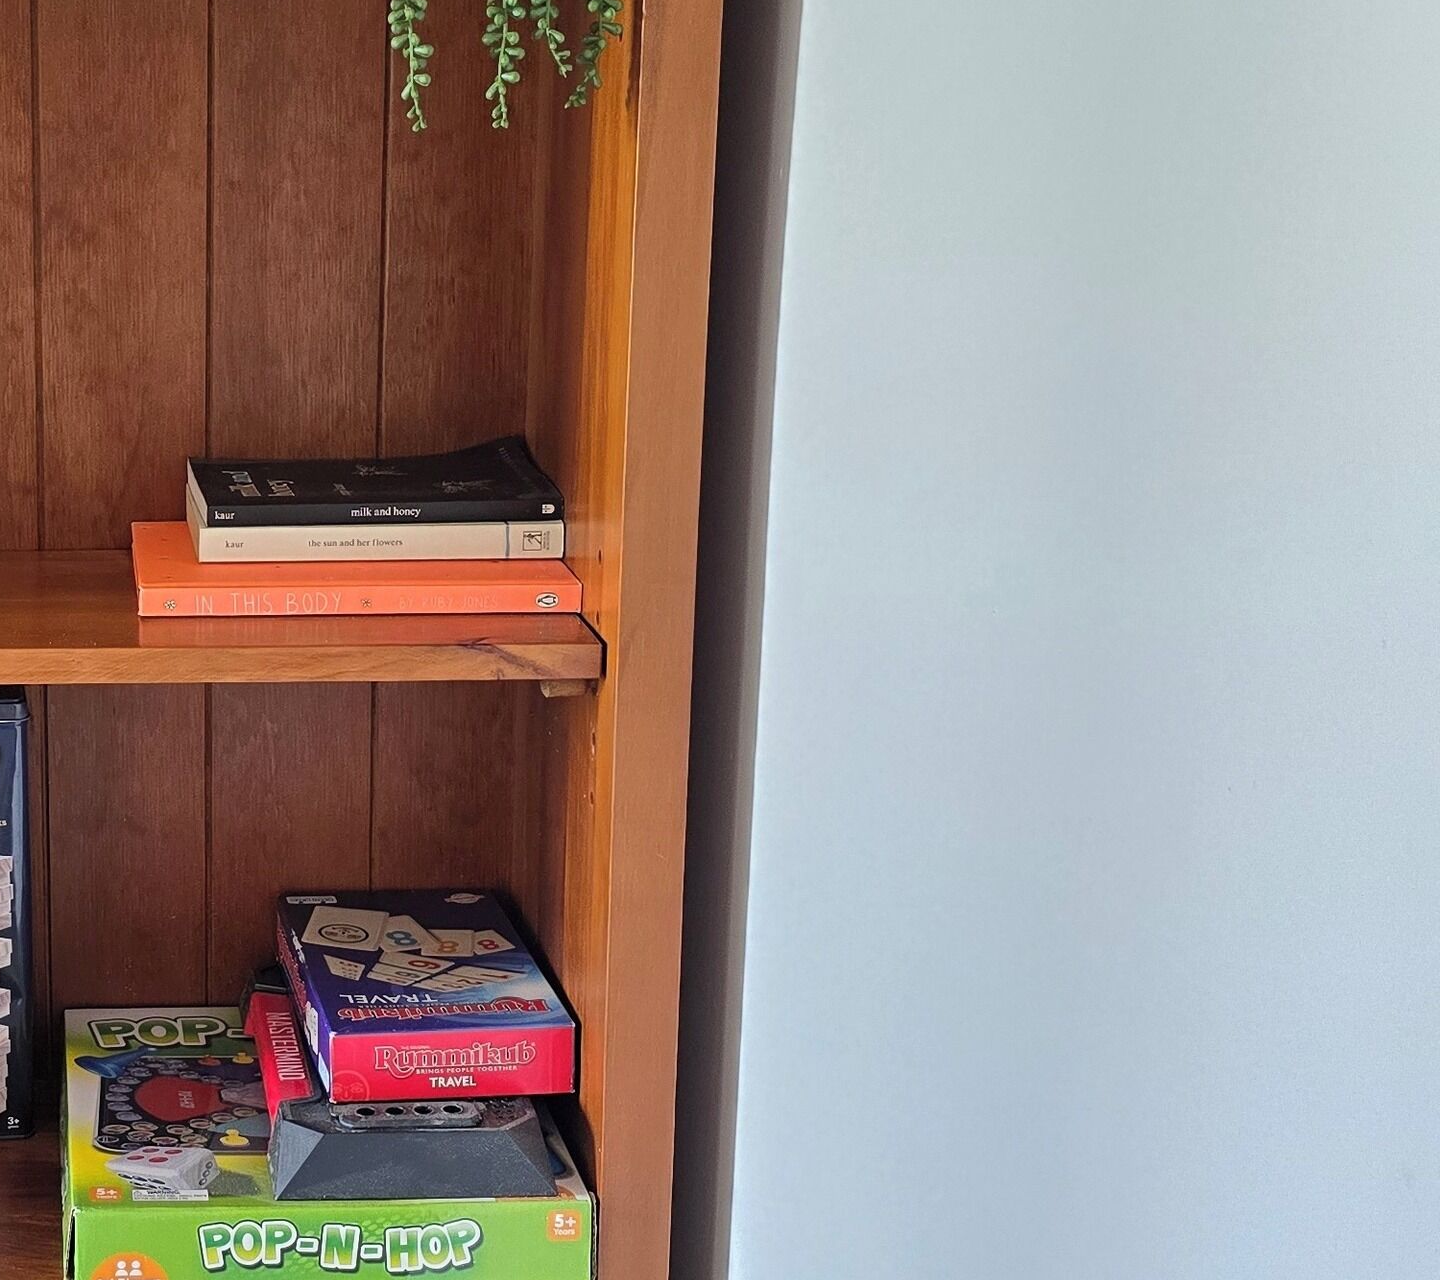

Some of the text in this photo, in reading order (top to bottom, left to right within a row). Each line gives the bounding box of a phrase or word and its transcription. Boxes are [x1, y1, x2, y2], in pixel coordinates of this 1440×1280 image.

[215, 511, 236, 519] kaur
[351, 506, 421, 518] milk and honey
[225, 540, 244, 548] kaur
[308, 539, 322, 547] the
[356, 538, 370, 546] her
[372, 538, 403, 546] flowers
[194, 591, 342, 614] IN THIS BODY
[463, 594, 498, 608] JONES
[339, 994, 438, 1004] TRAVEL
[338, 997, 551, 1021] Rummikub
[265, 1012, 306, 1081] MASTERMIND
[375, 1041, 536, 1079] Rummikub
[429, 1076, 476, 1087] TRAVEL
[554, 1214, 576, 1227] 5+
[553, 1228, 576, 1236] Years
[198, 1219, 482, 1274] POP-N-HOP
